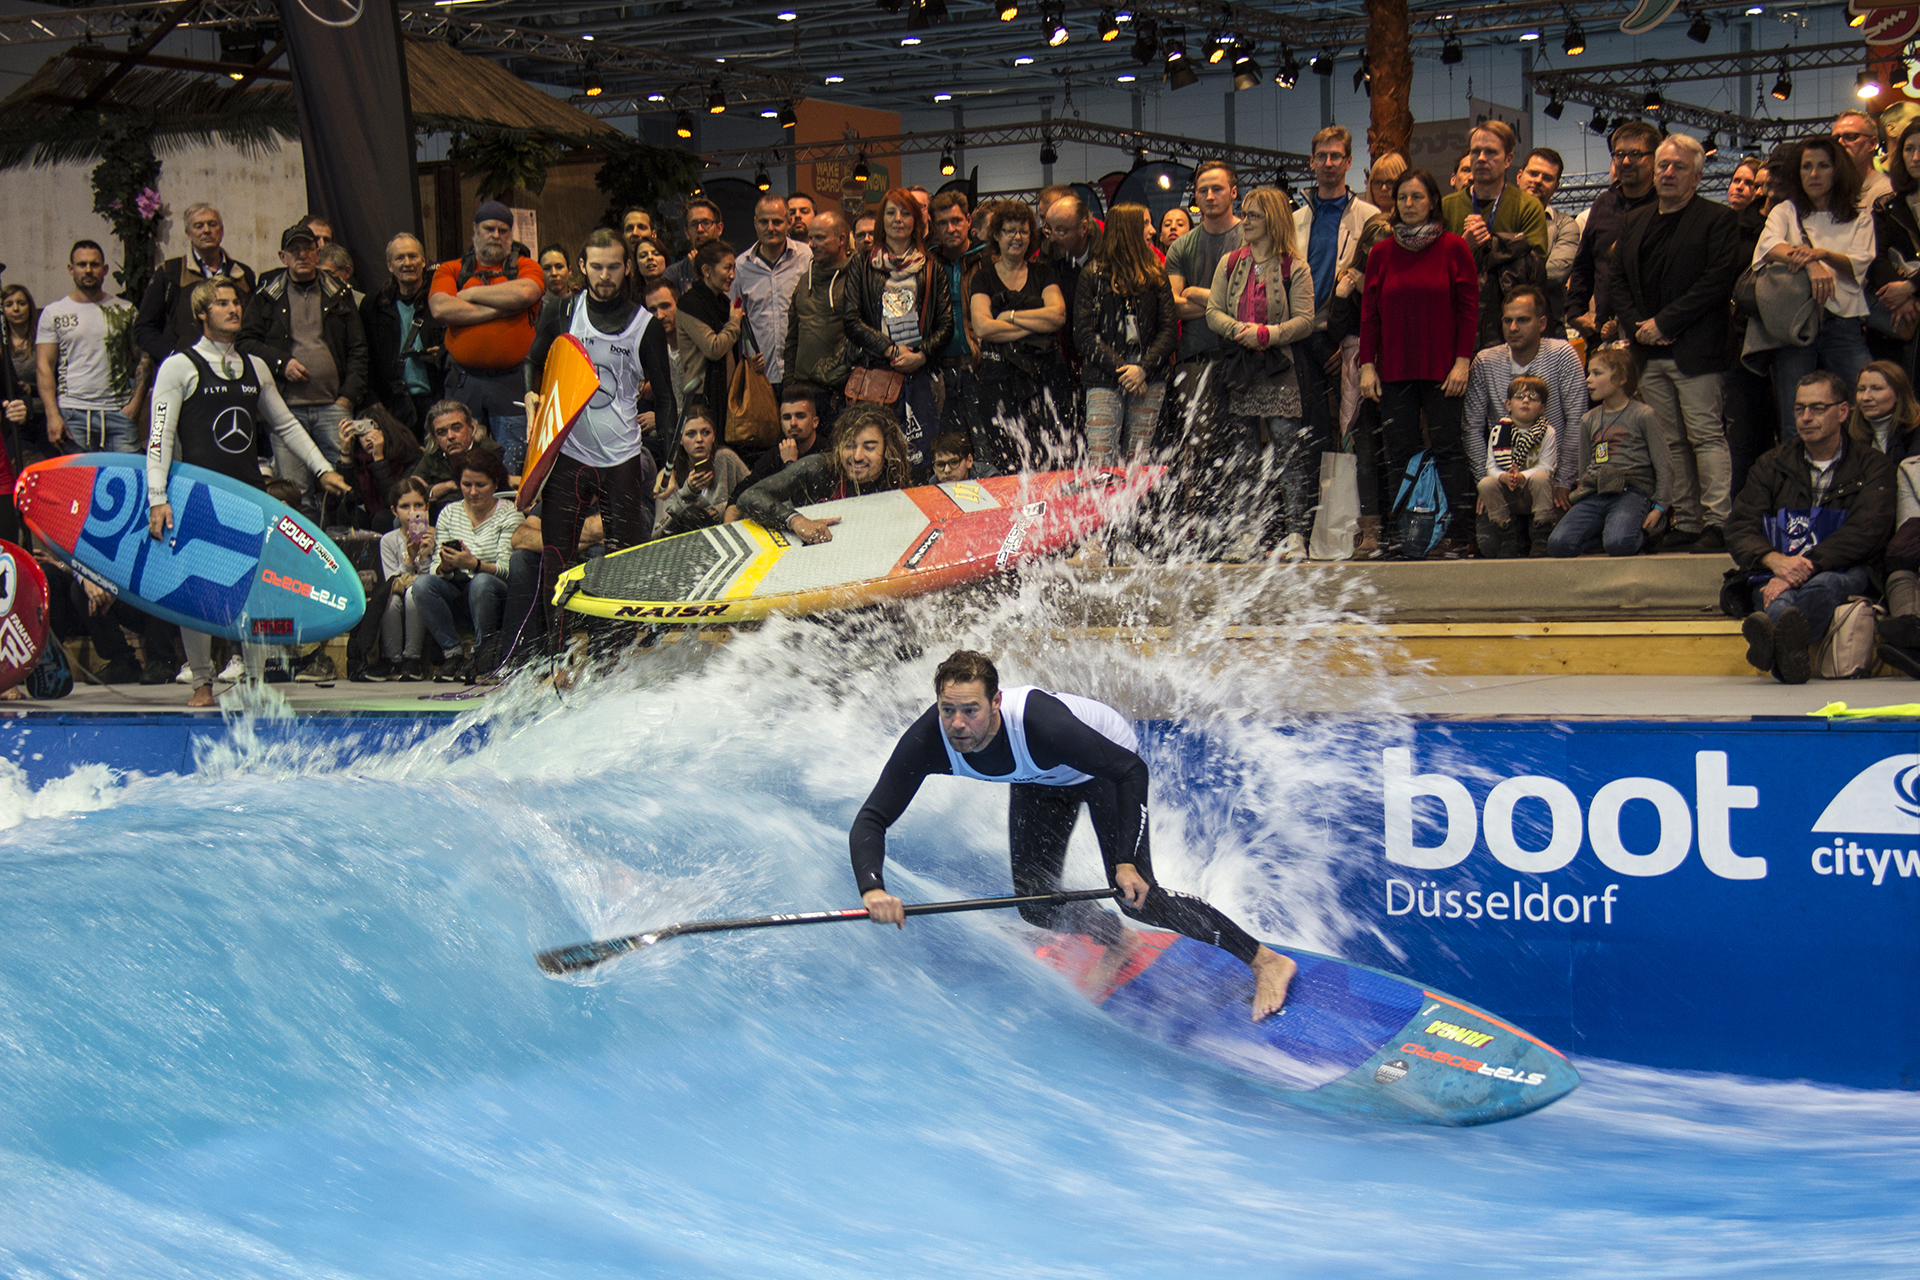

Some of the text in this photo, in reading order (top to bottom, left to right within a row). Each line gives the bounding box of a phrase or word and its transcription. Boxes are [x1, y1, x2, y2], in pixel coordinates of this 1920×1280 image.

[815, 161, 840, 178] WAKE
[816, 177, 840, 193] BOARD
[54, 314, 79, 329] 893
[278, 516, 315, 552] JANGA
[614, 603, 731, 618] NAISH
[9, 613, 38, 654] FANATIC
[1382, 747, 1767, 880] boot
[1385, 877, 1619, 925] Düsseldorf
[1425, 1020, 1495, 1048] JANGA
